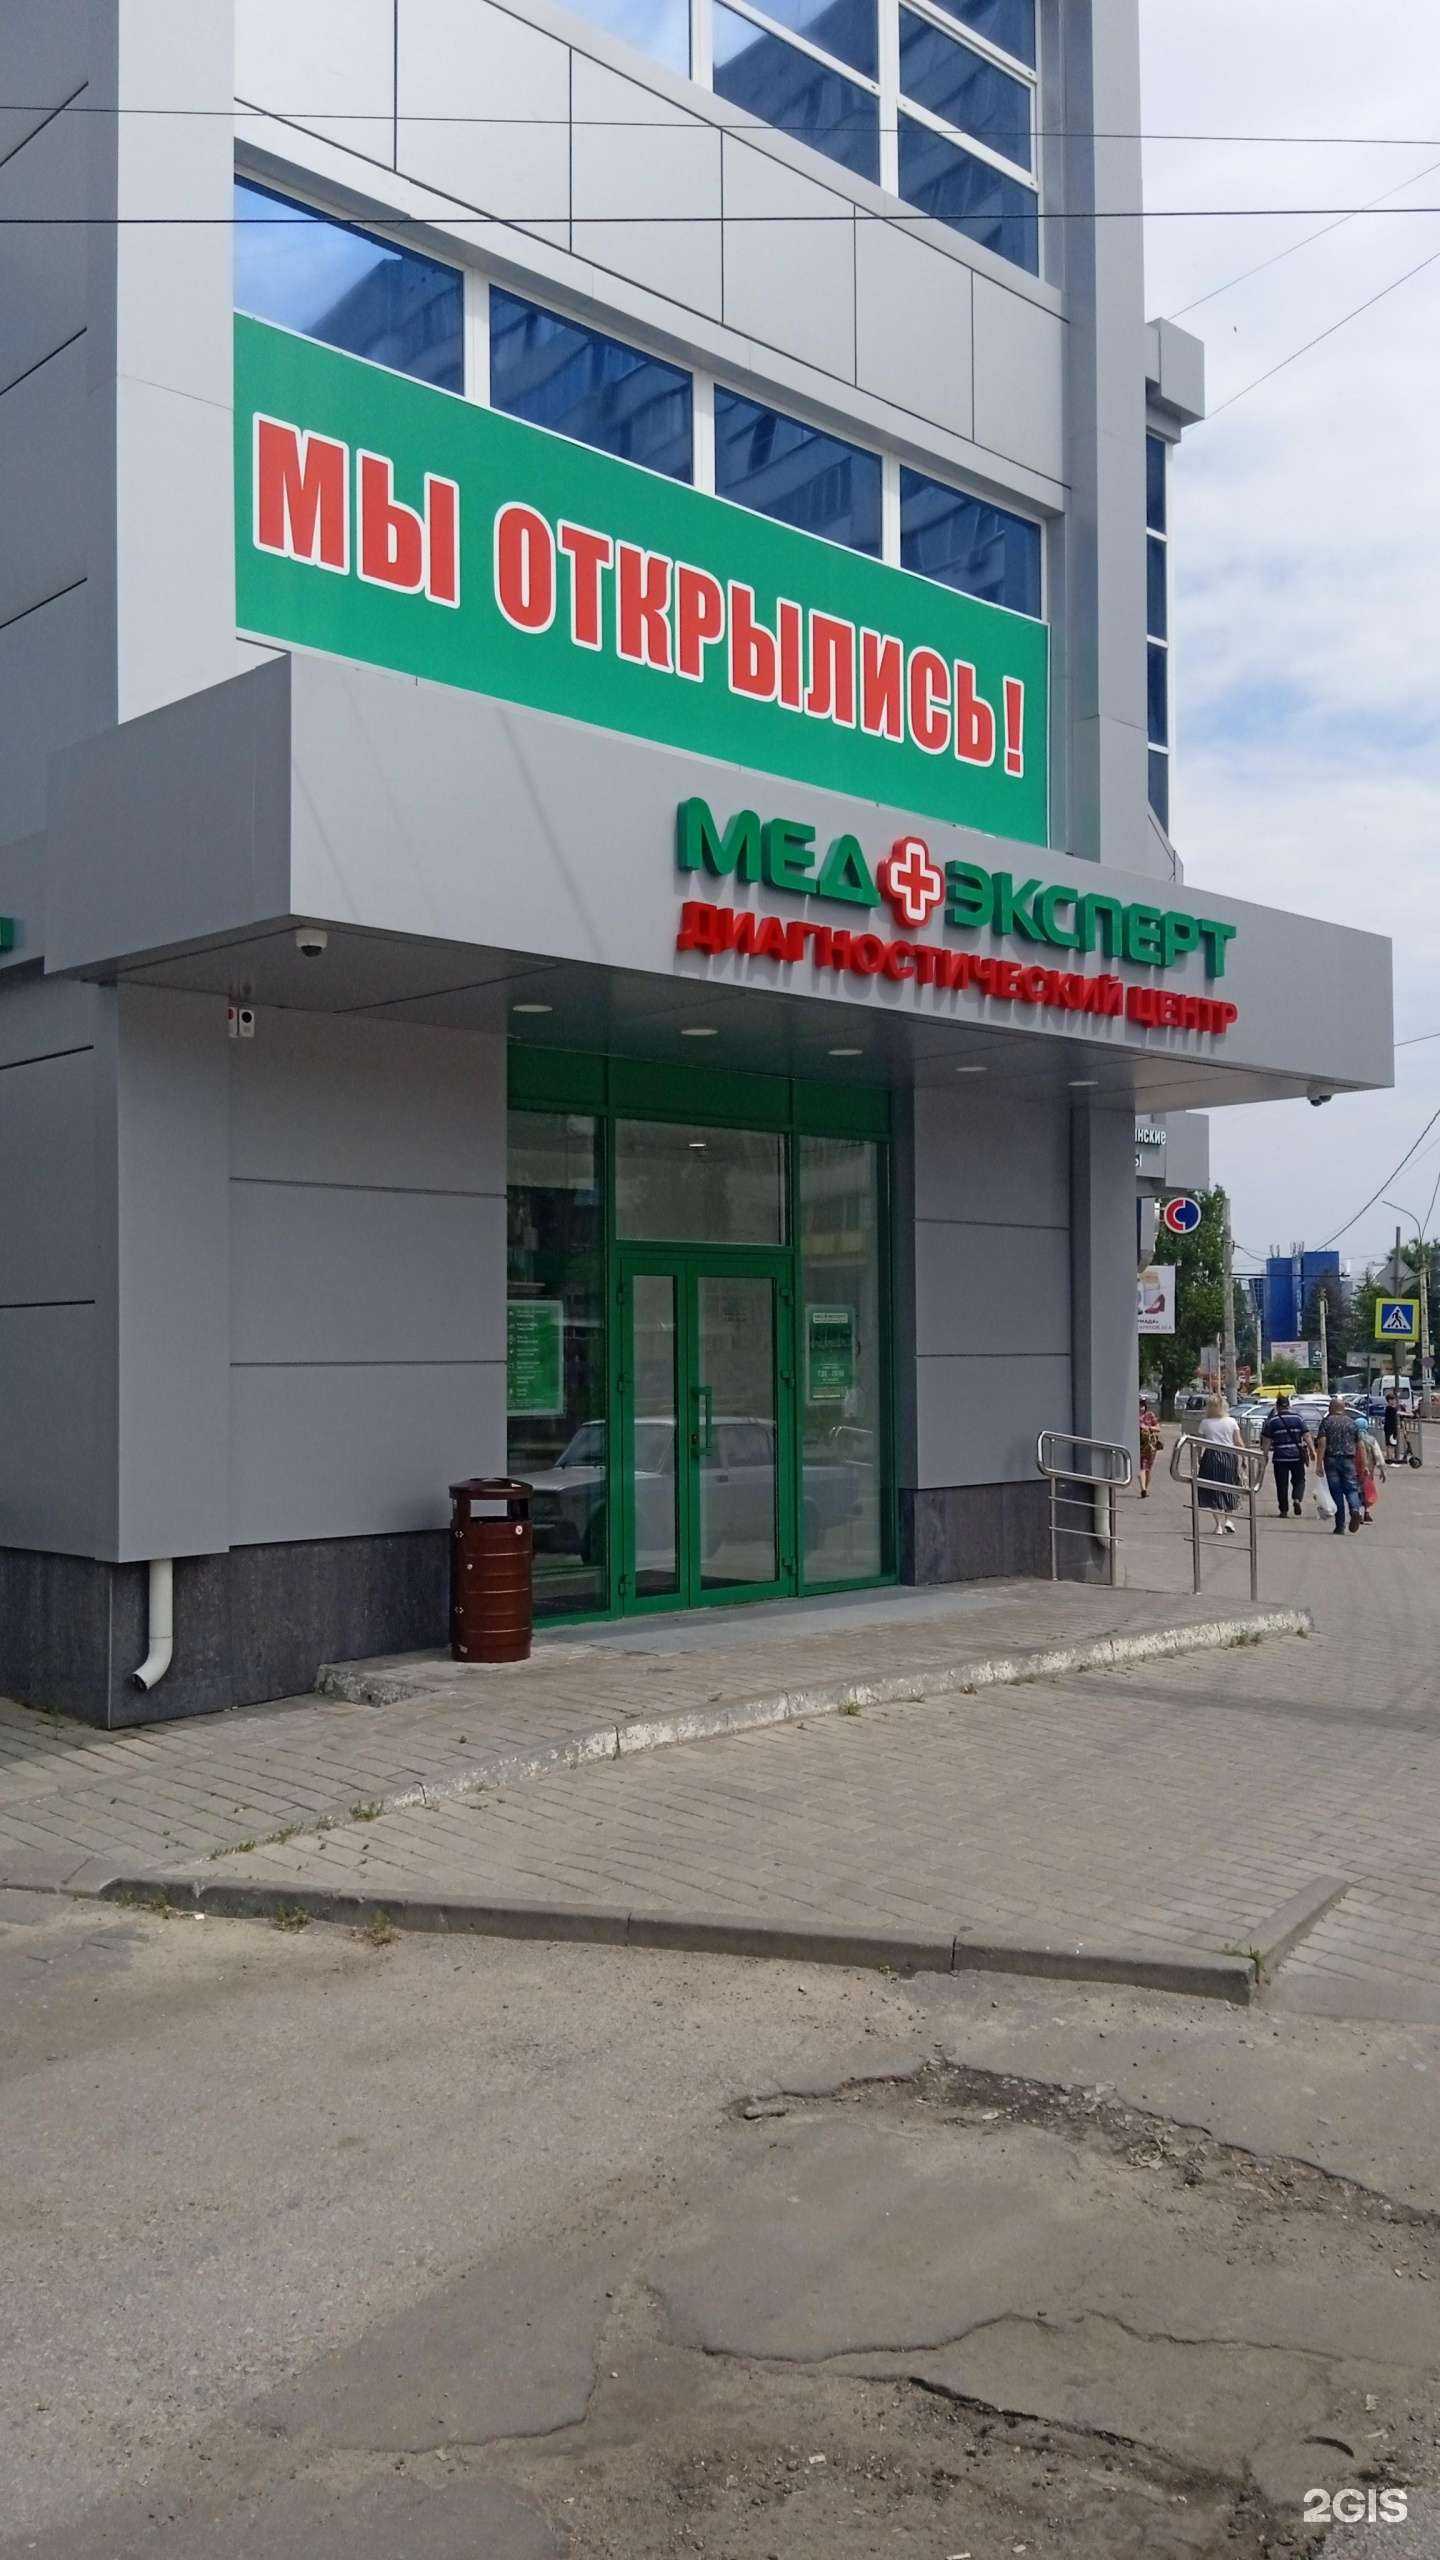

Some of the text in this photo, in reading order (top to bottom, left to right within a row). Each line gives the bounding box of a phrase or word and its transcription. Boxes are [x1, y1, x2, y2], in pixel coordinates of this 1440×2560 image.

[254, 412, 1024, 776] МЫ ОТКРЫЛИСЬ!
[677, 797, 1236, 978] МЕД ЭКСПЕРТ
[677, 901, 1238, 1034] ДИАГНОСТИЧЕСКИЙ ЦЕНТР
